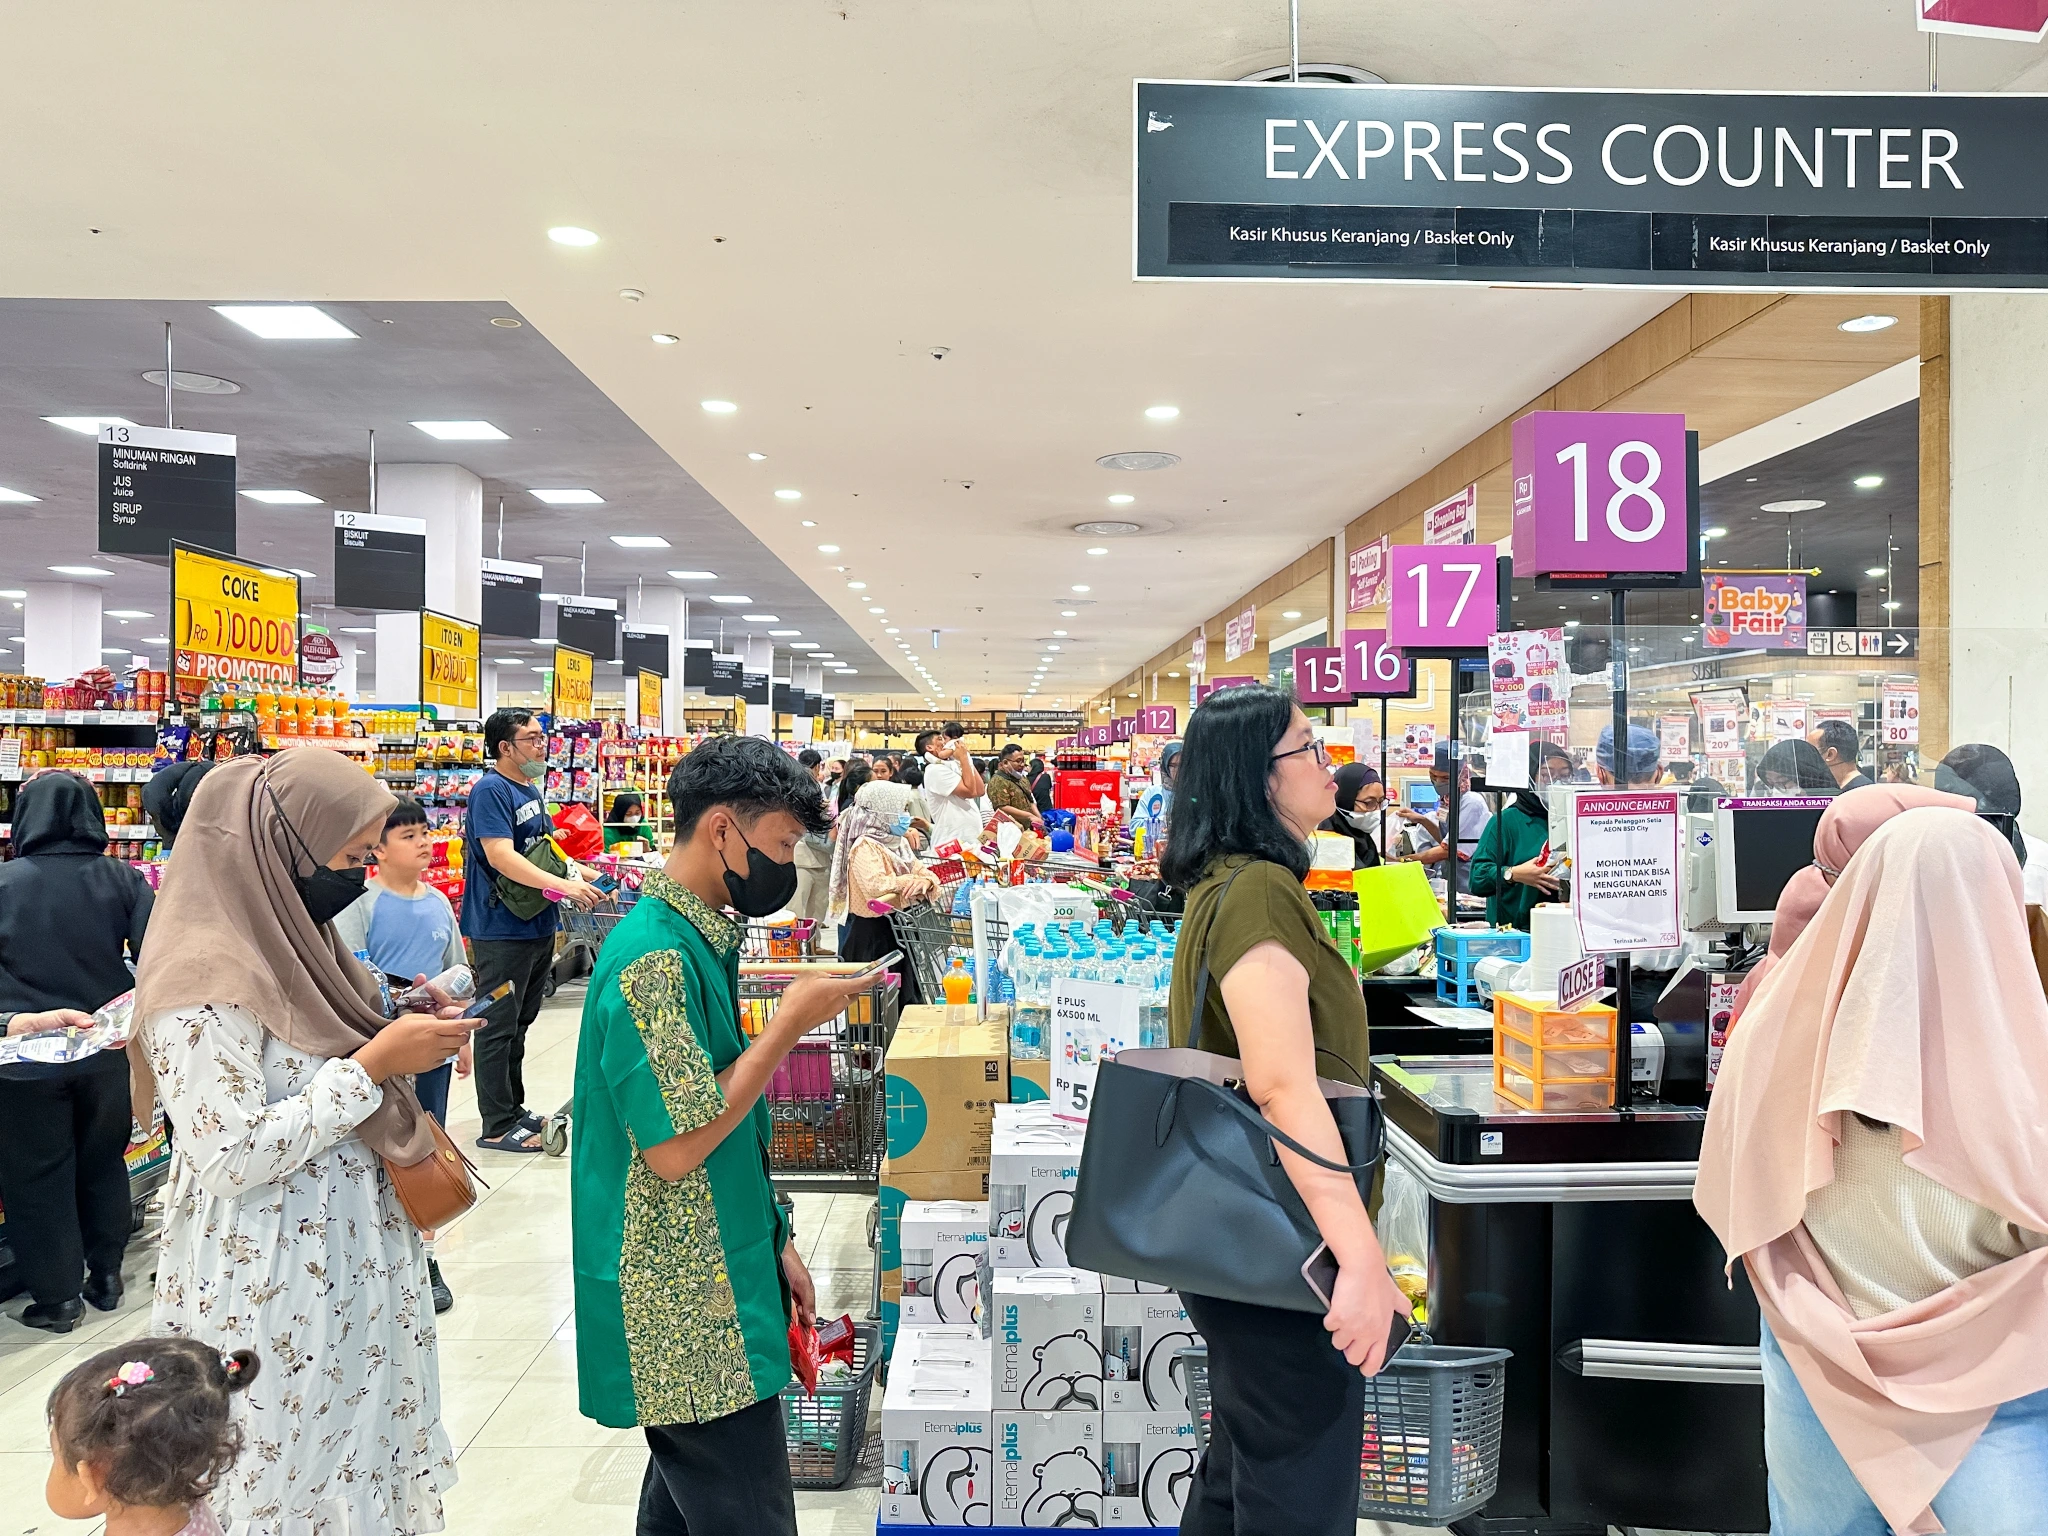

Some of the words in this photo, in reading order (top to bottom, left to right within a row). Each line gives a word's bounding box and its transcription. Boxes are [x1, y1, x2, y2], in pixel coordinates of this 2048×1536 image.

[1264, 118, 1573, 184] EXPRESS
[1601, 123, 1964, 189] COUNTER
[1229, 227, 1267, 242] Kasir
[1271, 228, 1327, 243] Khusus
[1331, 229, 1410, 247] Keranjang
[1413, 230, 1420, 245] /
[1424, 230, 1474, 245] Basket
[1478, 231, 1514, 248] Only
[1710, 237, 1747, 252] Kasir
[1751, 238, 1805, 253] Khusus
[1808, 239, 1887, 257] Keranjang
[1890, 239, 1897, 254] /
[1901, 240, 1950, 255] Basket
[1953, 240, 1990, 257] Only
[105, 426, 130, 442] 13
[113, 447, 158, 462] MINUMAN
[160, 452, 196, 465] RINGAN
[113, 475, 132, 487] JUS
[113, 487, 134, 497] Juice
[1519, 481, 1528, 495] Rp
[1556, 440, 1666, 543] 18
[113, 502, 143, 514] SIRUP
[113, 513, 136, 525] Syrup
[339, 514, 355, 526] 12
[343, 530, 369, 540] BISKUIT
[222, 575, 259, 602] COKE
[561, 597, 572, 605] 10
[1406, 563, 1482, 628] 17
[1720, 588, 1790, 613] Baby
[1732, 612, 1785, 633] Fair
[194, 623, 208, 644] Rp
[454, 632, 463, 648] EN
[1353, 640, 1401, 681] 16
[197, 654, 293, 687] PROMOTION
[1304, 657, 1342, 693] 15
[1692, 661, 1721, 681] SUSHI
[1500, 683, 1523, 691] 9.000
[1149, 709, 1171, 729] 12
[1098, 728, 1107, 742] 8
[1890, 727, 1907, 740] 80
[1711, 741, 1729, 749] 209
[1583, 800, 1671, 812] ANNOUNCEMENT
[1614, 818, 1646, 826] Pelanggan
[1637, 825, 1649, 833] City
[1596, 859, 1631, 868] MOHON
[1633, 858, 1658, 866] MAAF
[1585, 871, 1609, 879] KASIR
[1624, 869, 1650, 877] TIDAK
[1651, 868, 1670, 876] BISA
[1593, 879, 1662, 889] MENGGUNAKAN
[1588, 891, 1646, 899] PEMBAYARAN
[1648, 889, 1668, 898] QRIS
[1562, 961, 1594, 1002] CLOSE
[1057, 996, 1062, 1004] E
[1064, 997, 1086, 1007] PLUS
[1057, 1009, 1085, 1020] 6X500
[1087, 1013, 1100, 1022] ML
[986, 1062, 997, 1072] 40
[1056, 1078, 1070, 1091] Rp
[1071, 1083, 1088, 1110] 5
[1031, 1165, 1079, 1180] Eternalplu
[937, 1231, 987, 1244] Eternalplus
[999, 1247, 1005, 1255] 6
[908, 1305, 914, 1313] 6
[1086, 1306, 1092, 1315] 6
[1147, 1306, 1189, 1320] Eternalp
[1001, 1304, 1023, 1393] Eternalplus
[1114, 1391, 1120, 1399] 6
[924, 1421, 983, 1435] Eternalplus
[1086, 1423, 1092, 1432] 6
[1146, 1423, 1196, 1436] Eternalplu
[1001, 1422, 1023, 1511] Eternalplus
[891, 1504, 898, 1513] 6
[1113, 1507, 1119, 1515] 6
